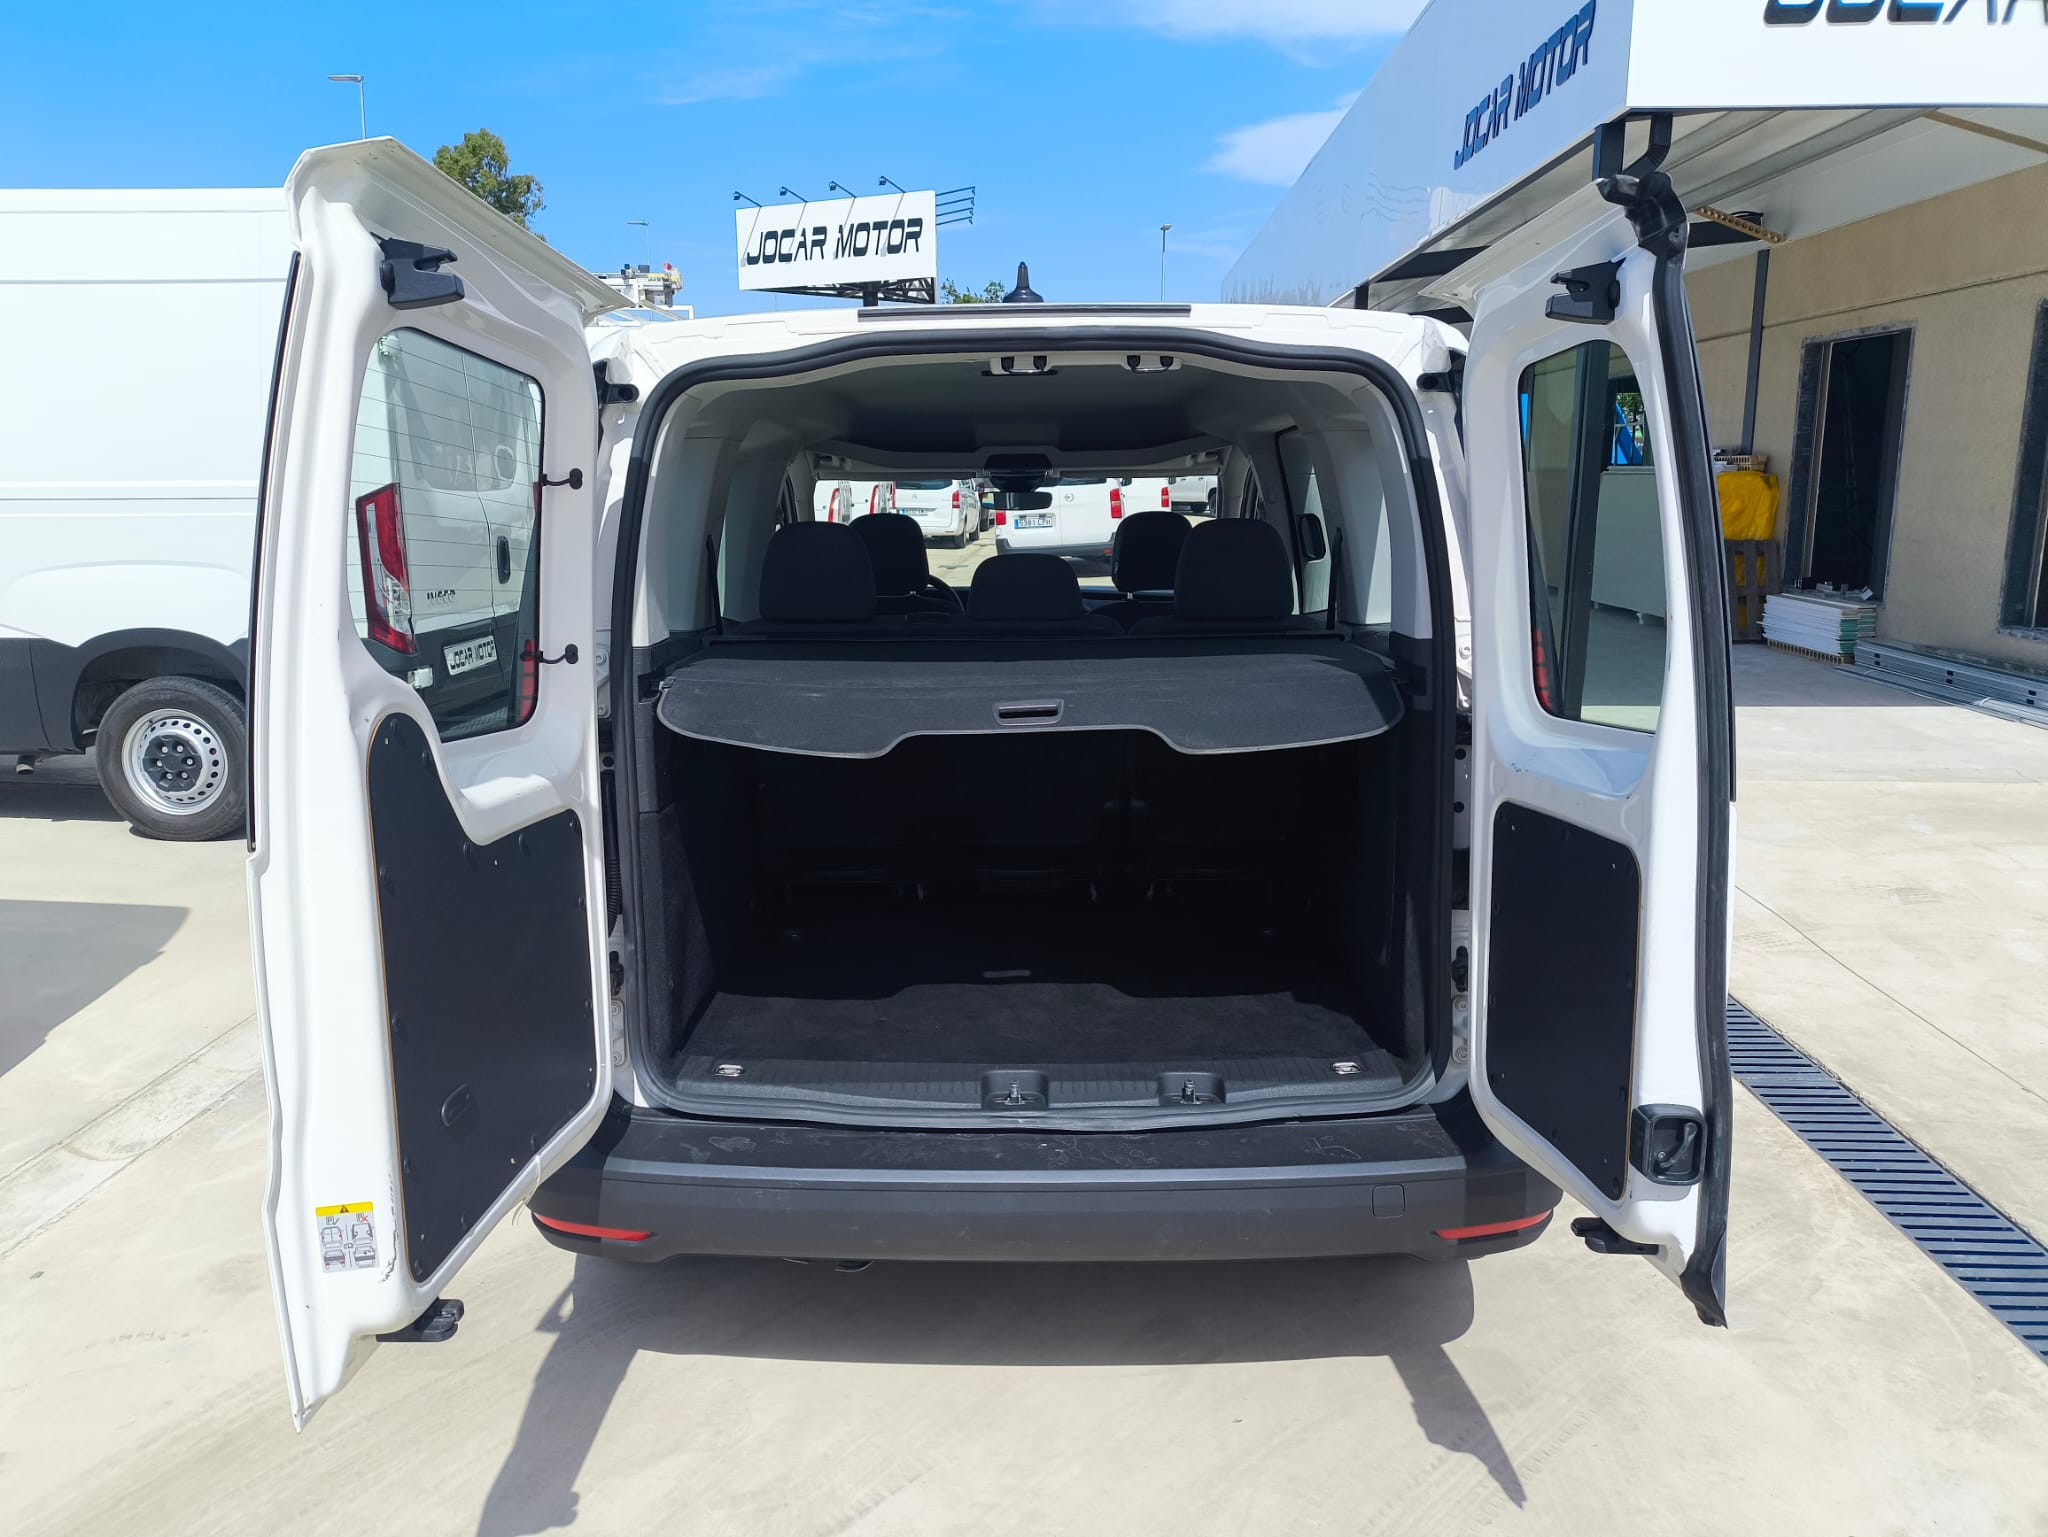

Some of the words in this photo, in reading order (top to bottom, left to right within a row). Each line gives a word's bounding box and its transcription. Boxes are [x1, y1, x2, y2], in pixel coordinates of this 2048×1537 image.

[1454, 74, 1513, 170] JOCAR
[1514, 0, 1596, 121] MOTOR
[746, 226, 827, 265] JOCAR
[835, 218, 923, 260] MOTOR
